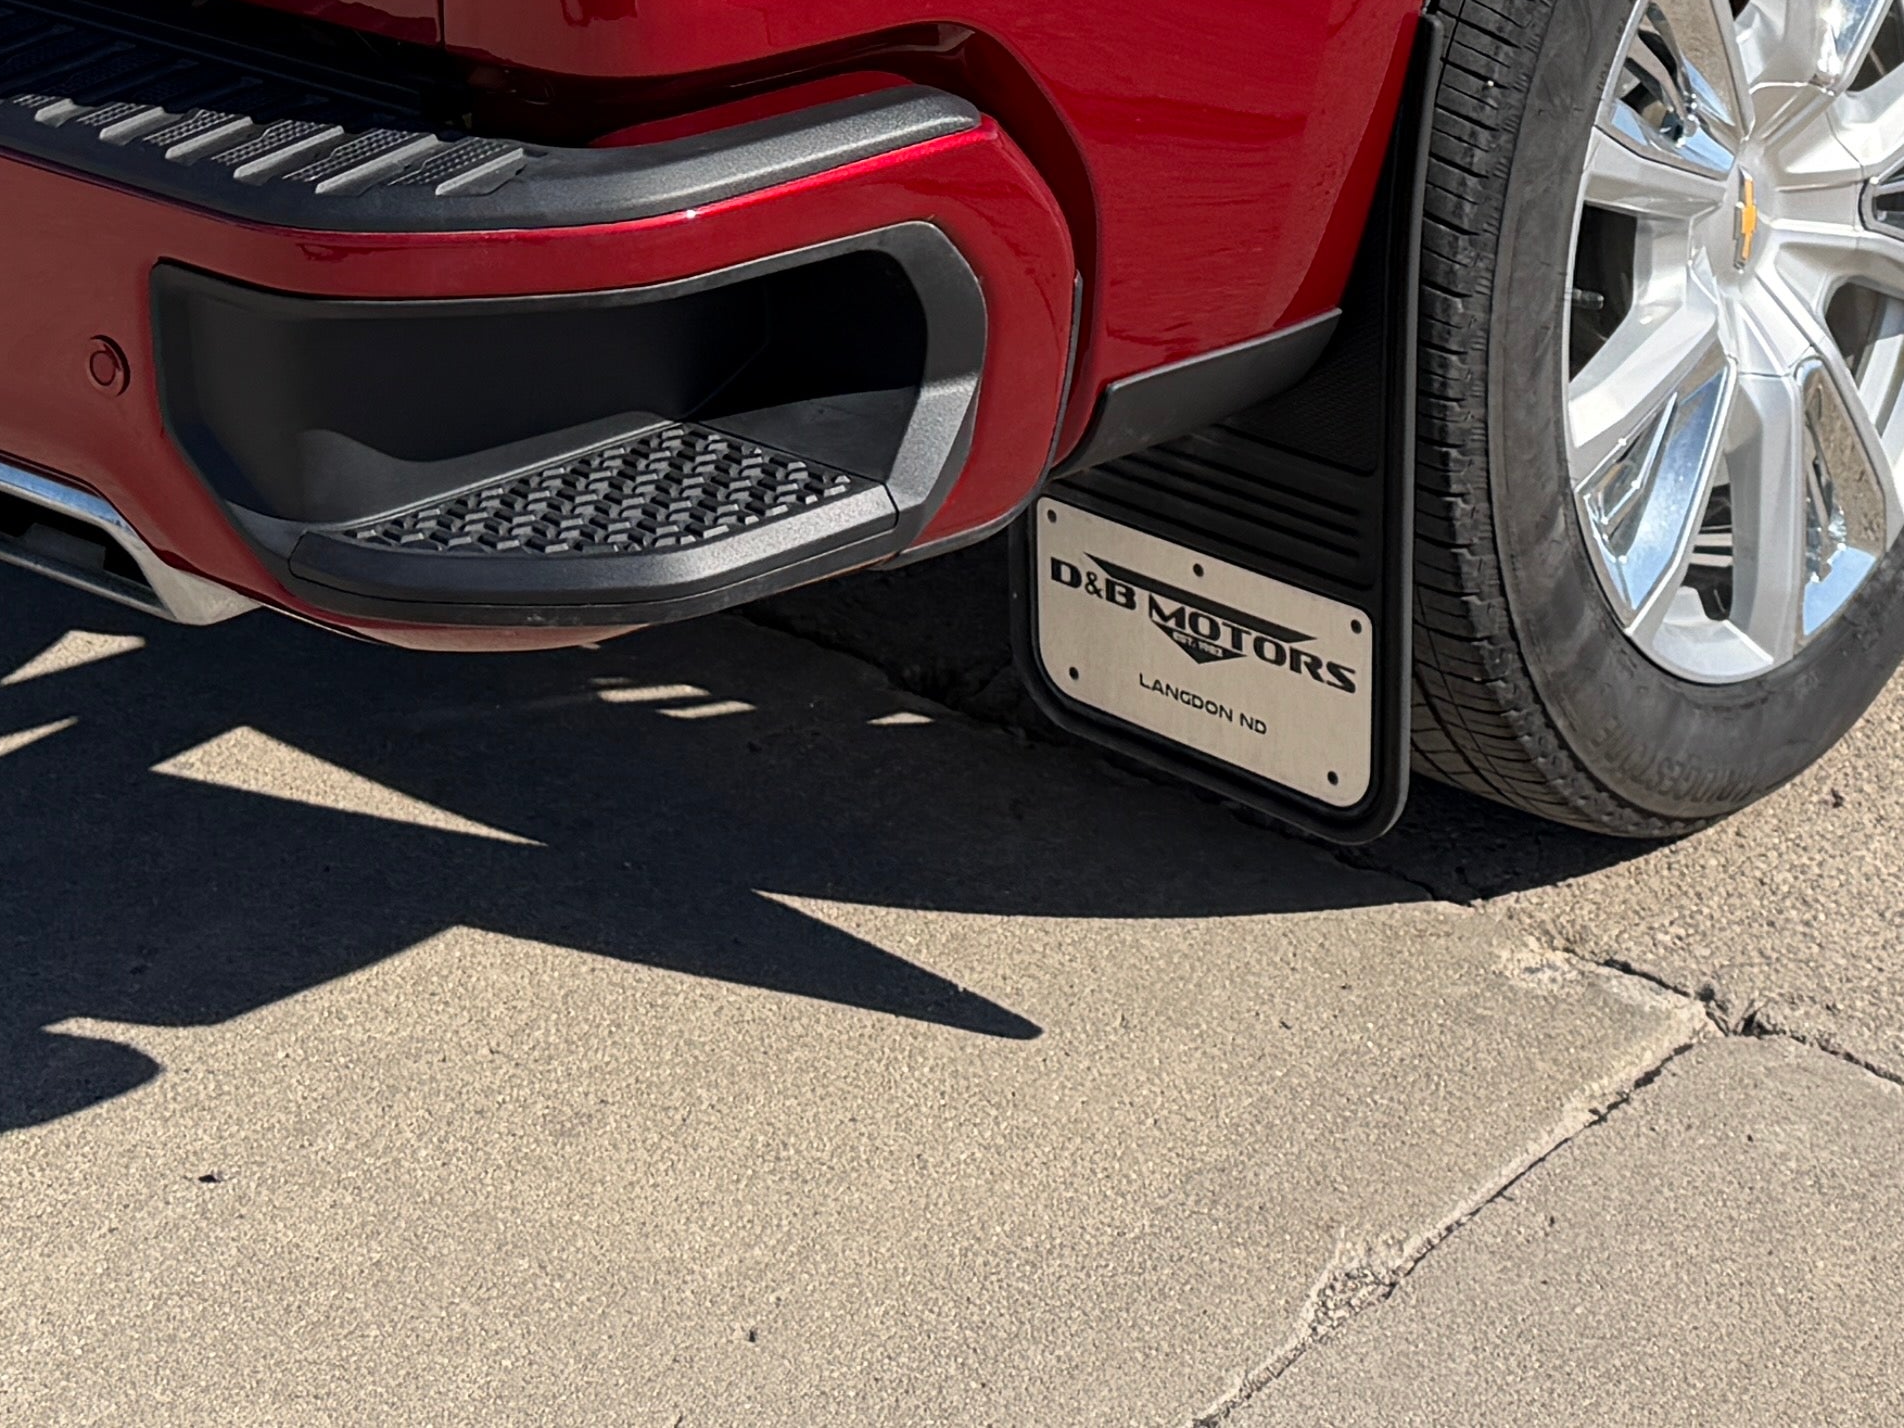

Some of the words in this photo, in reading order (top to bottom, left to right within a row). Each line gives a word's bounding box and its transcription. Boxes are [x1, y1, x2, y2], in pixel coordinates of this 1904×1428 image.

[1050, 556, 1137, 611] D&B
[1148, 593, 1357, 694] MOTORS
[1139, 673, 1234, 722] LANGDON
[1239, 712, 1268, 735] ND
